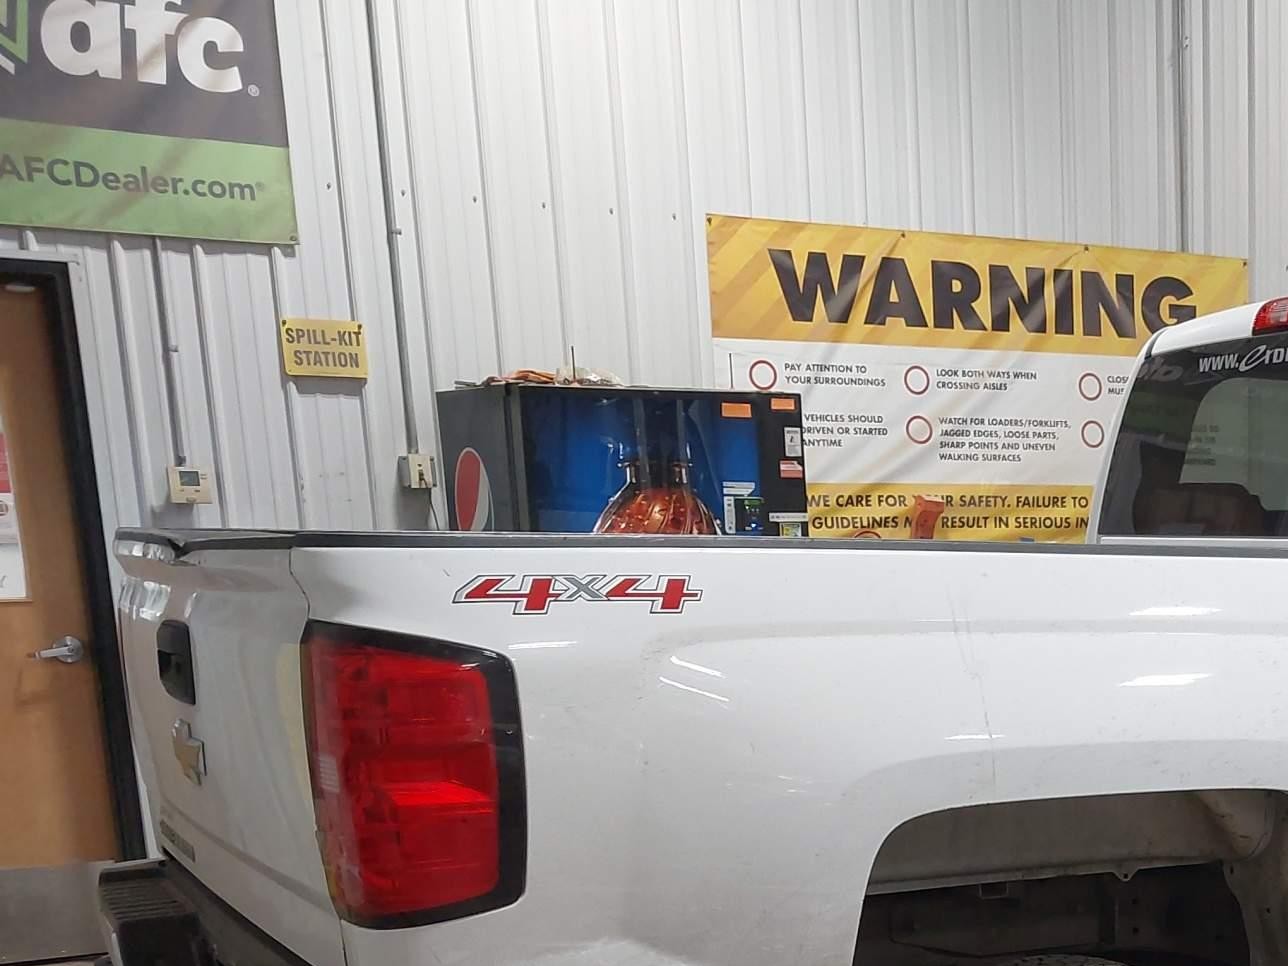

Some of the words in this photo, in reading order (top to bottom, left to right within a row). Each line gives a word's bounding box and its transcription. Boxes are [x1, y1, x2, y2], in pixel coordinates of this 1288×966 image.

[41, 0, 243, 93] afc
[767, 247, 1197, 338] WARNING
[285, 327, 362, 347] SPILL-KIT
[294, 350, 359, 368] STATION
[784, 363, 802, 372] PAY
[805, 363, 853, 373] ATTENTION
[855, 365, 867, 374] TO
[936, 369, 959, 377] LOOK
[962, 369, 985, 378] BOTH
[987, 370, 1011, 379] WAYS
[1012, 371, 1037, 380] WHEN
[785, 375, 812, 385] YOUR
[814, 376, 886, 387] SURROUNDINGS
[936, 381, 980, 390] CROSSING
[983, 382, 1008, 391] AISLES
[804, 413, 845, 423] VEHICLES
[848, 414, 884, 424] SHOULD
[939, 417, 968, 426] WATCH
[970, 417, 985, 426] FOR
[988, 418, 1071, 429] LOADERS/FORKLIFTS,
[802, 427, 834, 435] DRIVEN
[837, 427, 850, 435] OR
[853, 427, 888, 436] STARTED
[940, 429, 971, 438] JAGGED
[973, 429, 1001, 439] EDGES,
[1003, 431, 1030, 439] LOOSE
[1032, 431, 1059, 440] PARTS,
[802, 439, 843, 447] ANYTIME
[939, 441, 966, 449] SHARP
[968, 441, 999, 450] POINTS
[1001, 442, 1020, 450] AND
[1022, 442, 1056, 451] UNEVEN
[939, 453, 979, 461] WALKING
[981, 453, 1022, 462] SURFACES
[808, 494, 830, 507] WE
[835, 494, 872, 507] CARE
[878, 494, 908, 507] FOR
[959, 495, 1011, 508] SAFETY.
[1016, 495, 1067, 508] FAILURE
[1071, 496, 1089, 509] TO
[812, 516, 899, 529] GUIDELINES
[941, 516, 990, 529] RESULT
[994, 516, 1009, 529] IN
[1014, 516, 1071, 529] SERIOUS
